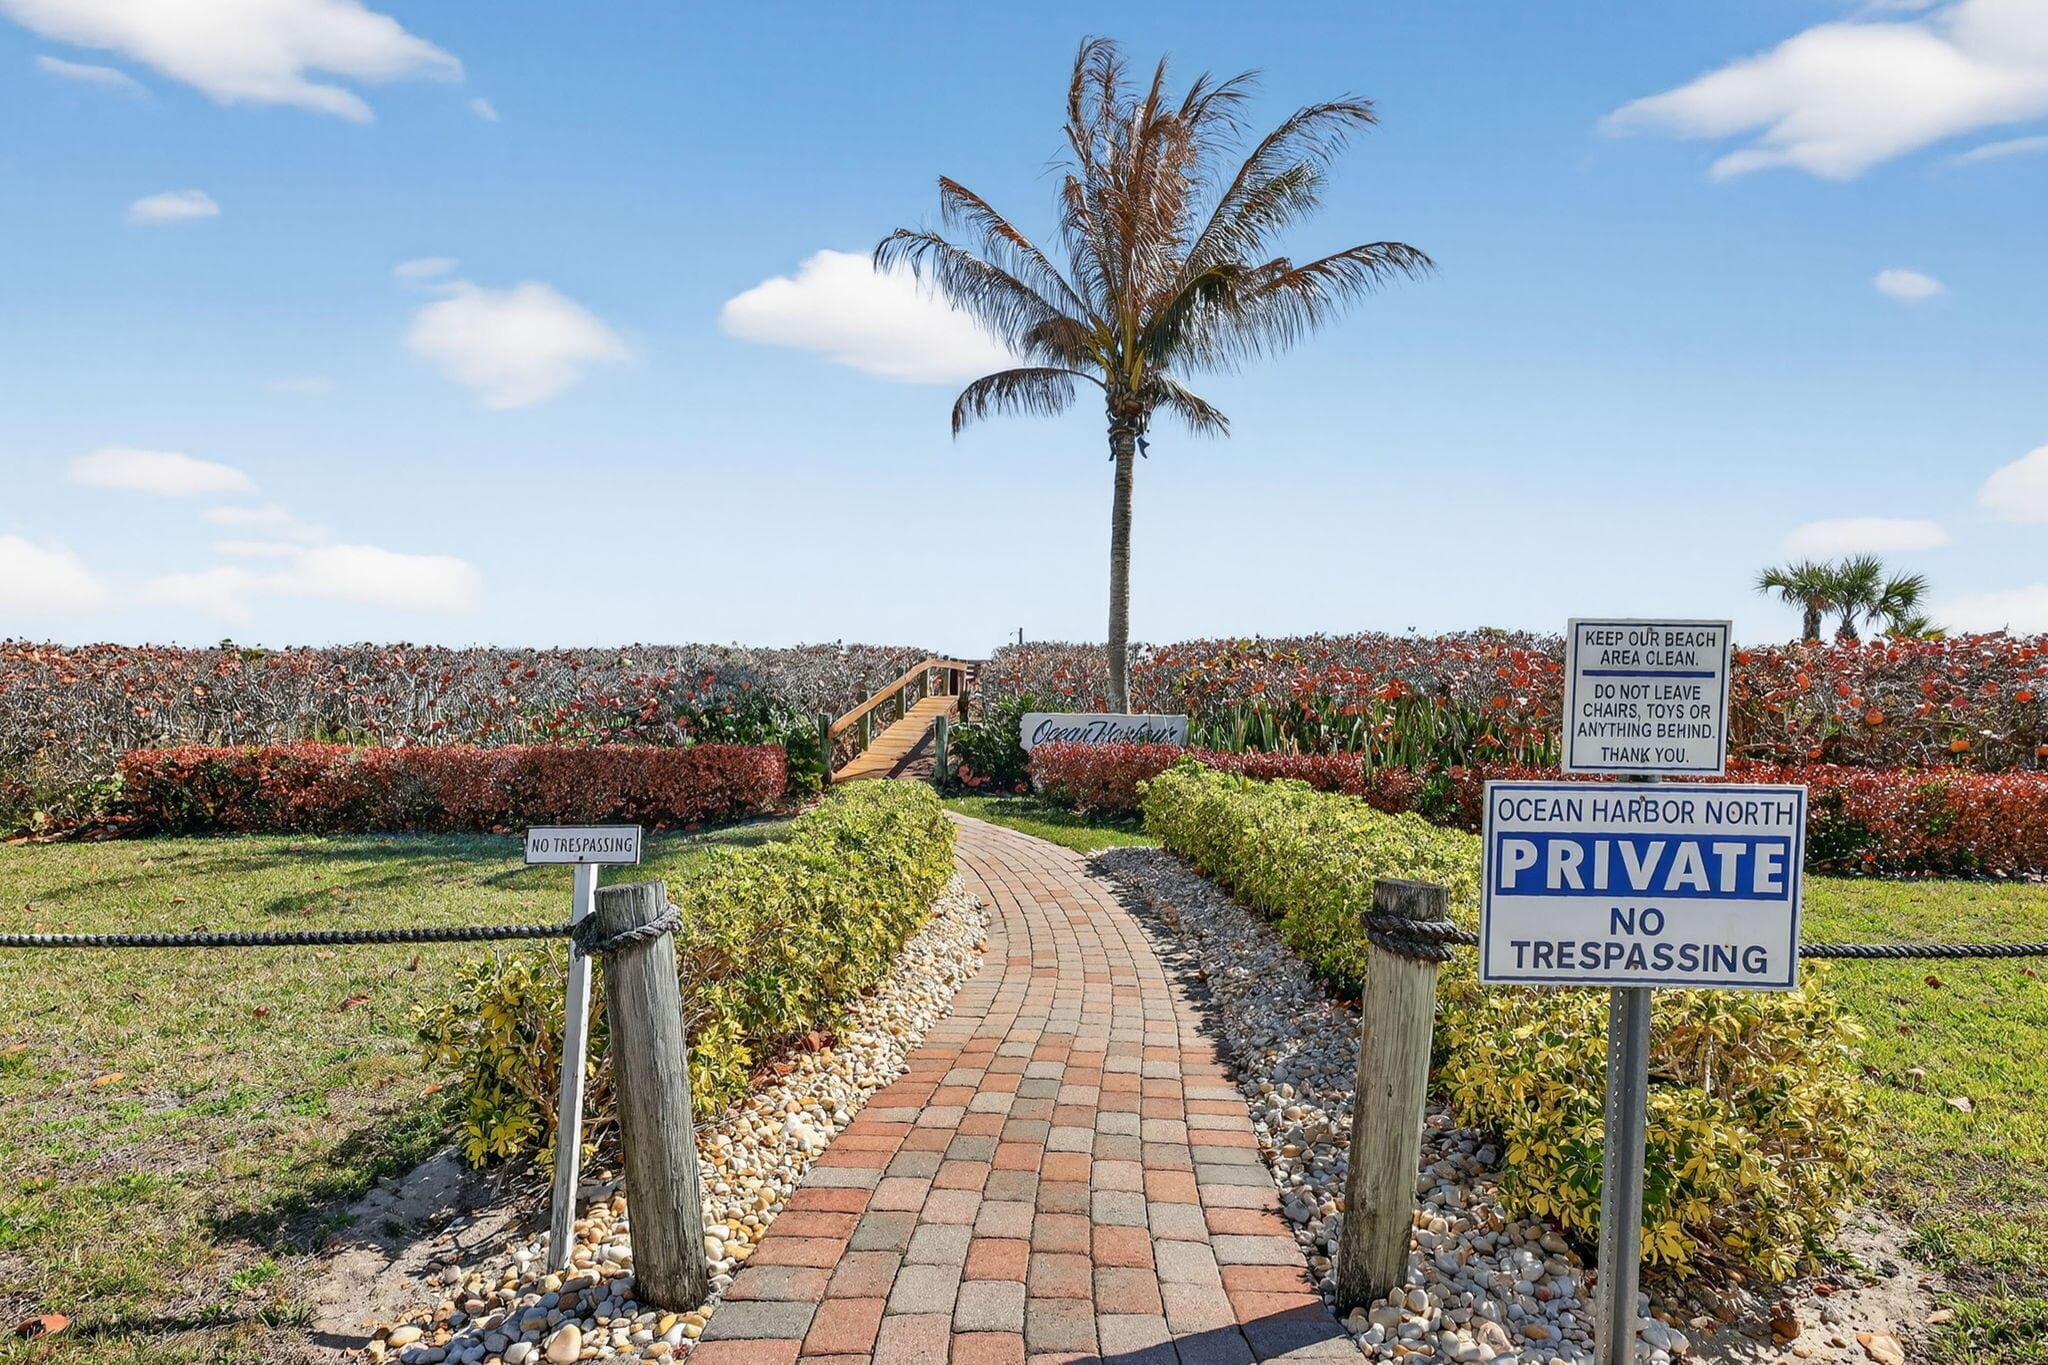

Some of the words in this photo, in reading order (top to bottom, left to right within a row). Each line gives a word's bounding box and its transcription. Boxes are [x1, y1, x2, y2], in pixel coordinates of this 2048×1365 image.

[1585, 631, 1624, 646] KEEP
[1628, 631, 1659, 647] OUR
[1664, 632, 1716, 647] BEACH
[1600, 650, 1640, 665] AREA
[1645, 651, 1699, 666] CLEAN.
[1594, 684, 1615, 699] DO
[1620, 684, 1650, 700] NOT
[1654, 685, 1701, 700] LEAVE
[1583, 703, 1641, 721] CHAIRS,
[1647, 704, 1684, 719] TOYS
[1689, 704, 1711, 719] OR
[1032, 719, 1092, 745] Ocean
[1577, 722, 1652, 738] ANYTHING
[1657, 724, 1715, 739] BEHIND.
[1601, 747, 1650, 763] THANK
[1654, 748, 1689, 763] YOU.
[1499, 798, 1582, 822] OCEAN
[1592, 798, 1695, 824] HARBOR
[1705, 800, 1793, 826] NORTH
[531, 838, 549, 853] NO
[553, 837, 633, 852] TRESPASSING
[1500, 838, 1785, 894] PRIVATE
[1609, 907, 1665, 936] NO
[1510, 940, 1768, 974] TRESPASSING
